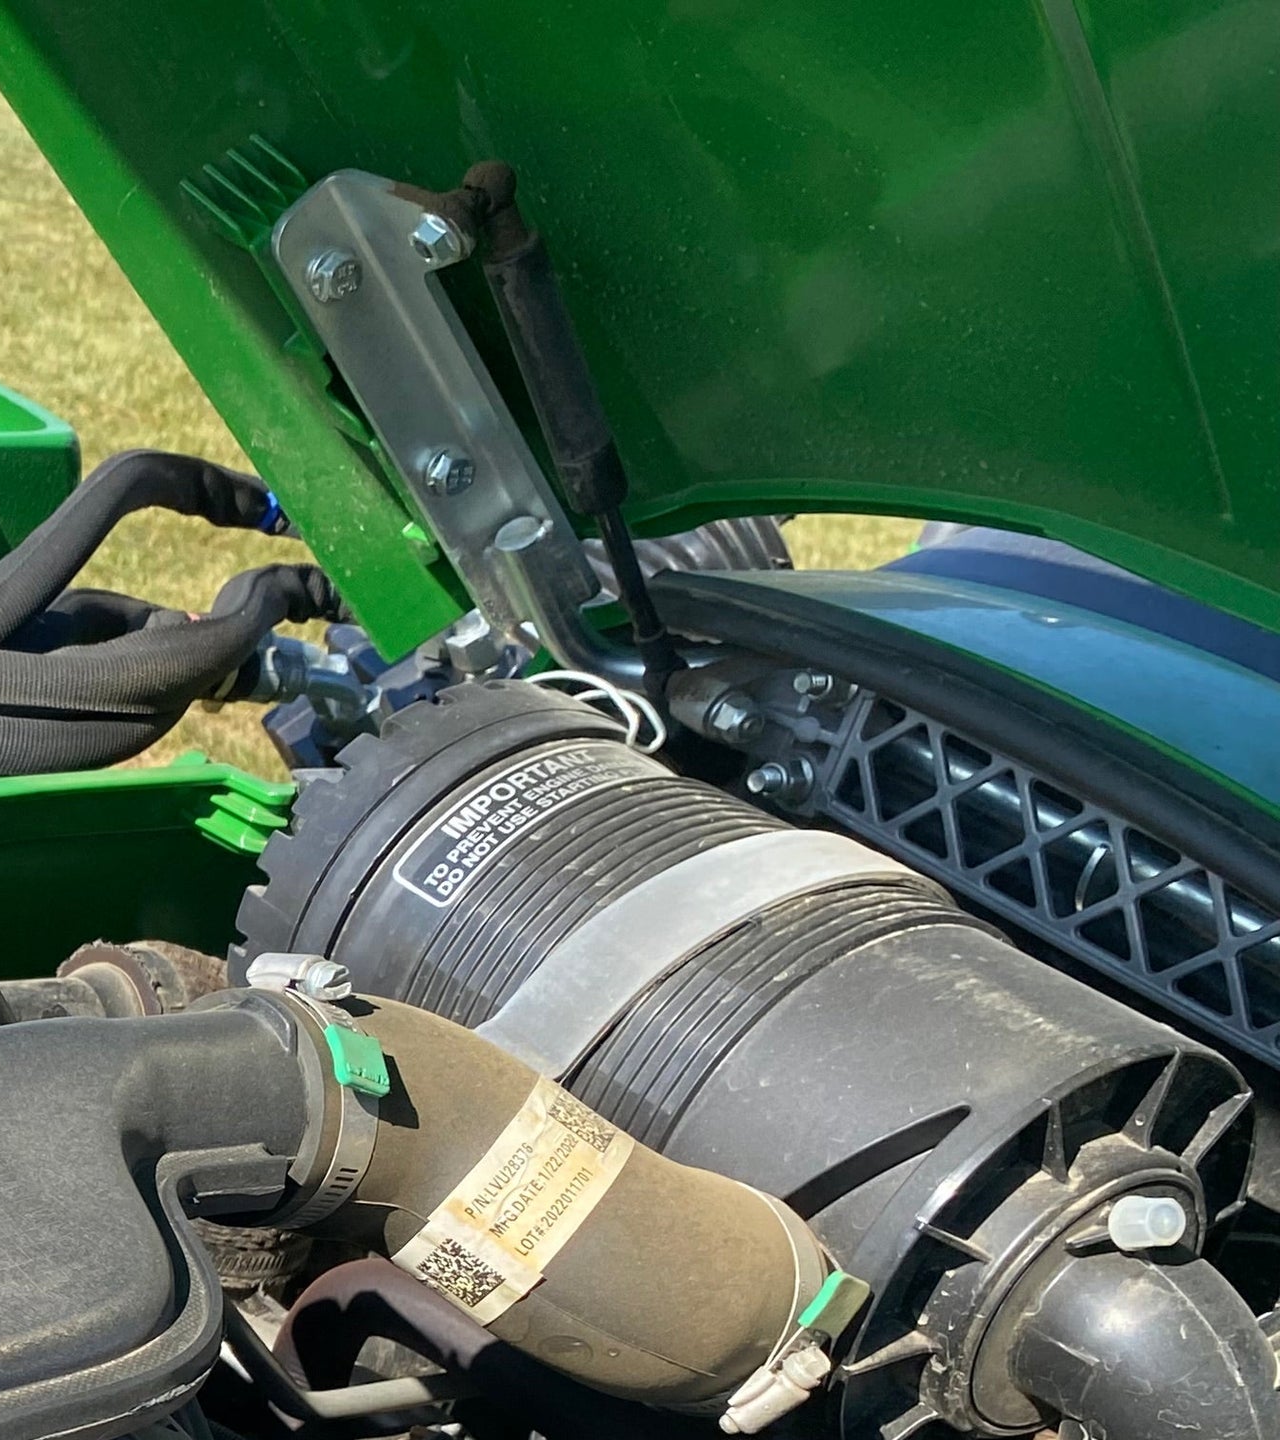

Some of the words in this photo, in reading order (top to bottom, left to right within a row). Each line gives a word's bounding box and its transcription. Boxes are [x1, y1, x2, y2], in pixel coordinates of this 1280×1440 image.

[423, 864, 449, 888] TO
[446, 798, 524, 863] PREVENT
[523, 766, 588, 800] ENGINE
[437, 868, 464, 896] DO
[462, 832, 500, 869] NOT
[498, 806, 539, 834] USE
[539, 769, 621, 809] STARTING
[441, 750, 596, 839] IMPORTANT
